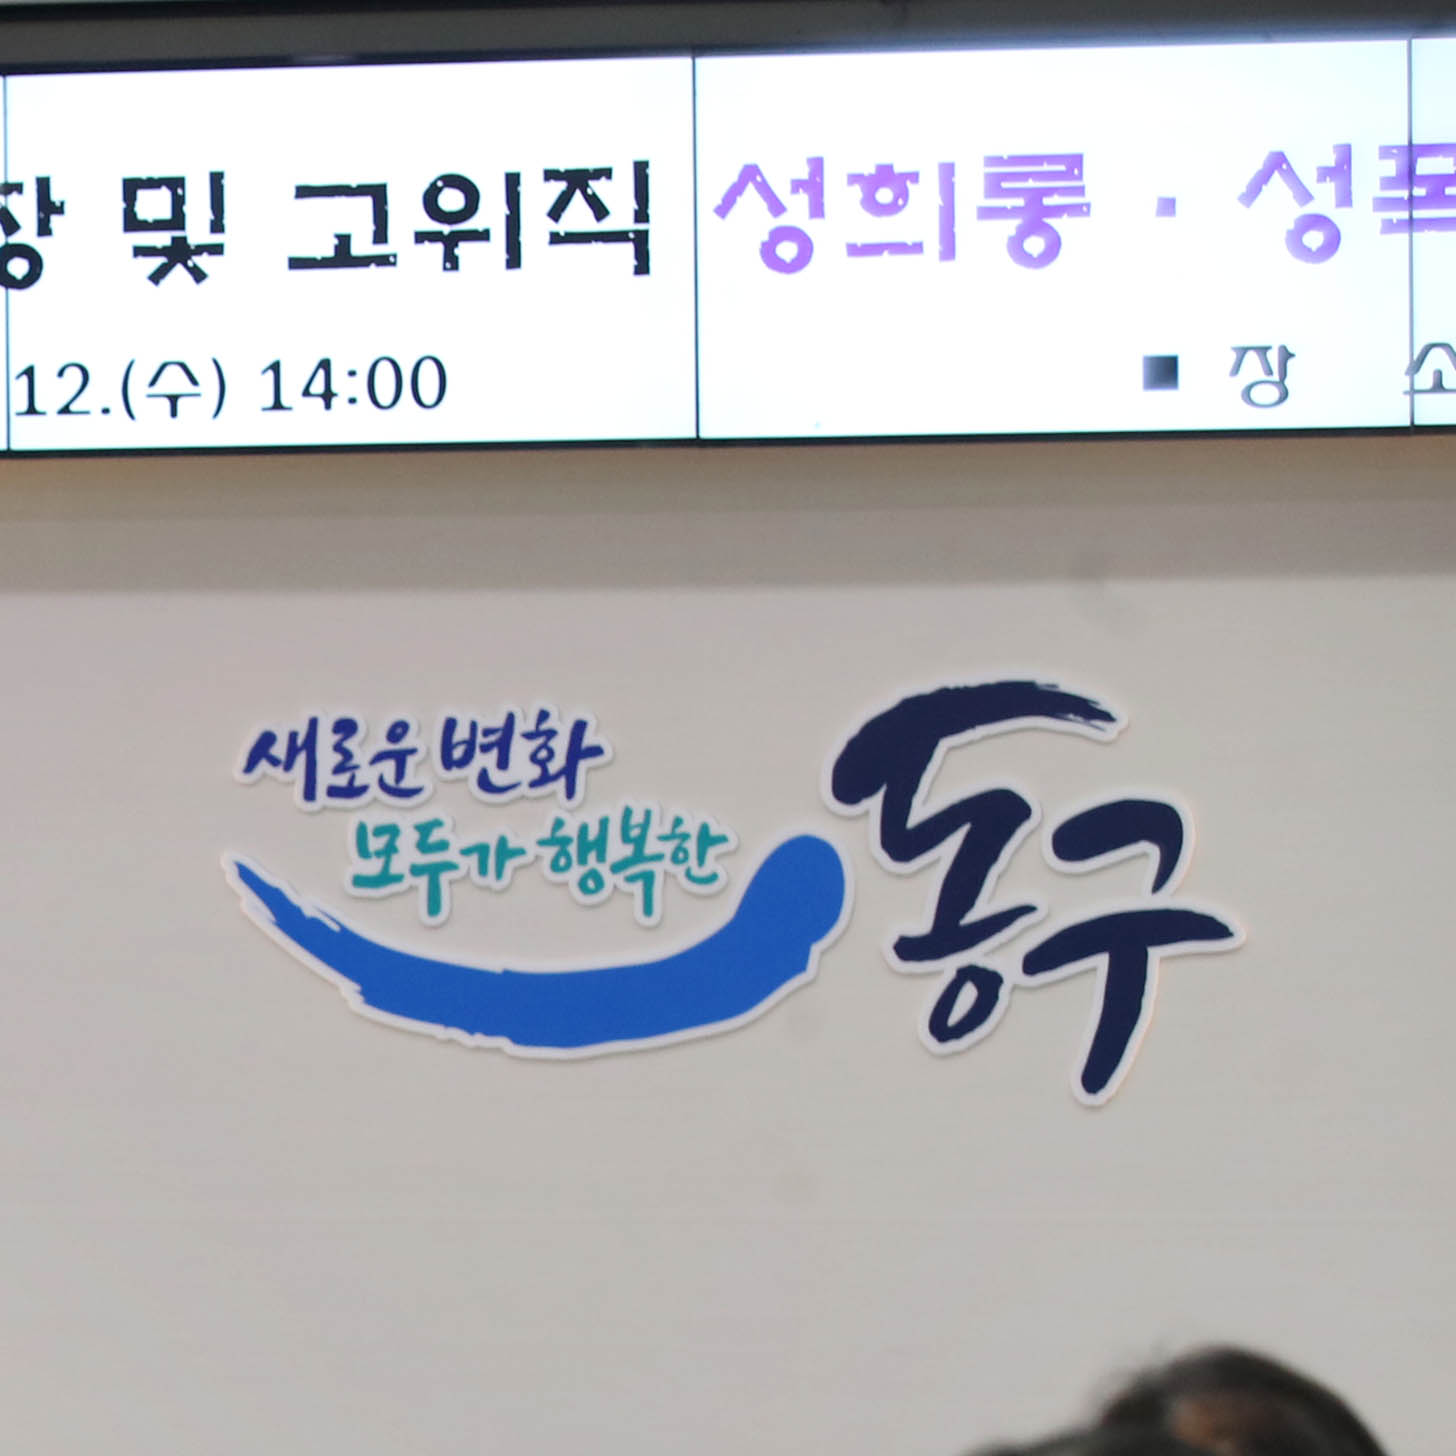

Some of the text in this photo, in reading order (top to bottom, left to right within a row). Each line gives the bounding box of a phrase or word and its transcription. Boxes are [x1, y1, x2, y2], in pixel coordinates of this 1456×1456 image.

[122, 171, 226, 287] 및
[287, 160, 651, 276] 고위직
[714, 153, 1091, 274] 성희롱
[15, 358, 227, 421] 12.(수)
[261, 355, 447, 412] 14:00
[243, 708, 606, 802] 새로운 변화
[352, 806, 728, 918] 모두가 행복한
[831, 680, 1234, 1095] 동구
